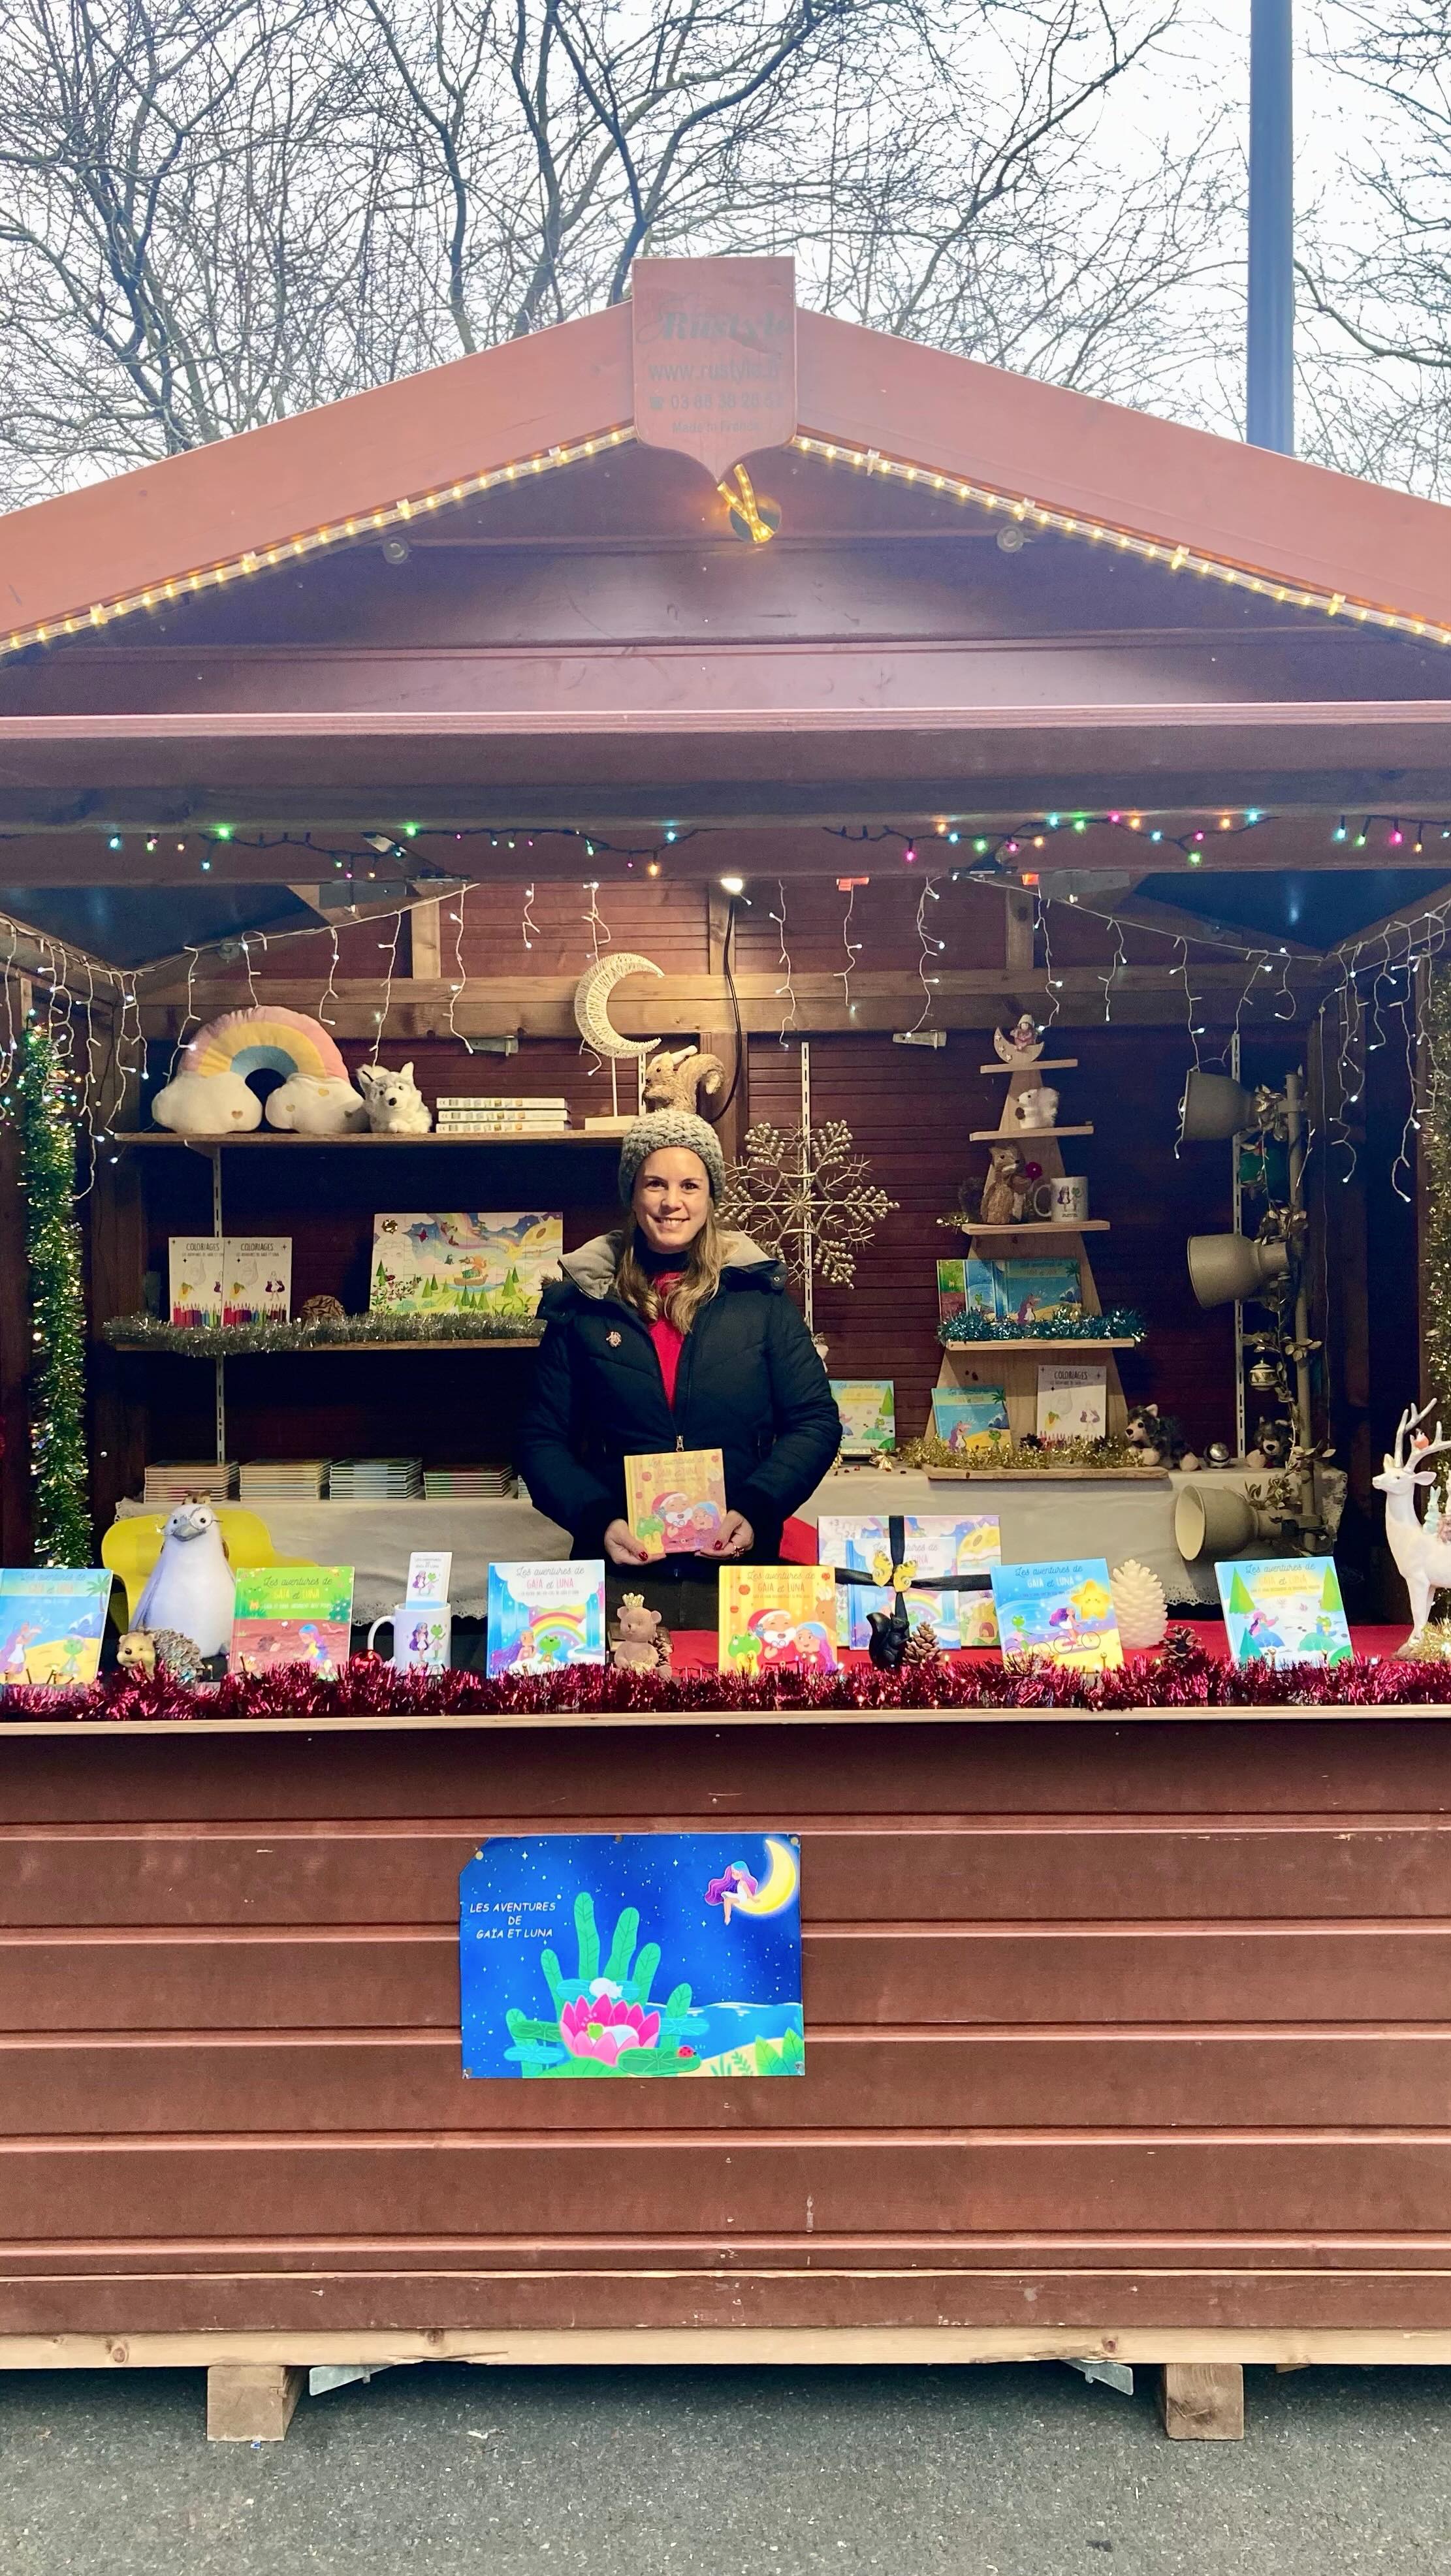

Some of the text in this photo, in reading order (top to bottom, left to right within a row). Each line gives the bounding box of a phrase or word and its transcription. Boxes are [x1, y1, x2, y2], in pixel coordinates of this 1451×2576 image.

[186, 1242, 220, 1251] COLORIAGES
[240, 1242, 274, 1251] COLORIAGES
[1054, 1370, 1088, 1380] COLORIAGES
[516, 1565, 584, 1578] Les aventures de
[1015, 1564, 1083, 1578] Les aventures de
[1245, 1562, 1316, 1575] Les aventures de
[747, 1571, 815, 1581] Les aventures de
[264, 1576, 333, 1588] Les aventures de
[556, 1577, 574, 1588] LUNA
[777, 1584, 785, 1593] et
[788, 1582, 805, 1592] LUNA
[470, 1901, 556, 1913] LES AVENTURES
[507, 1915, 522, 1925] DE
[476, 1928, 553, 1940] GAÏA ET LUNA
